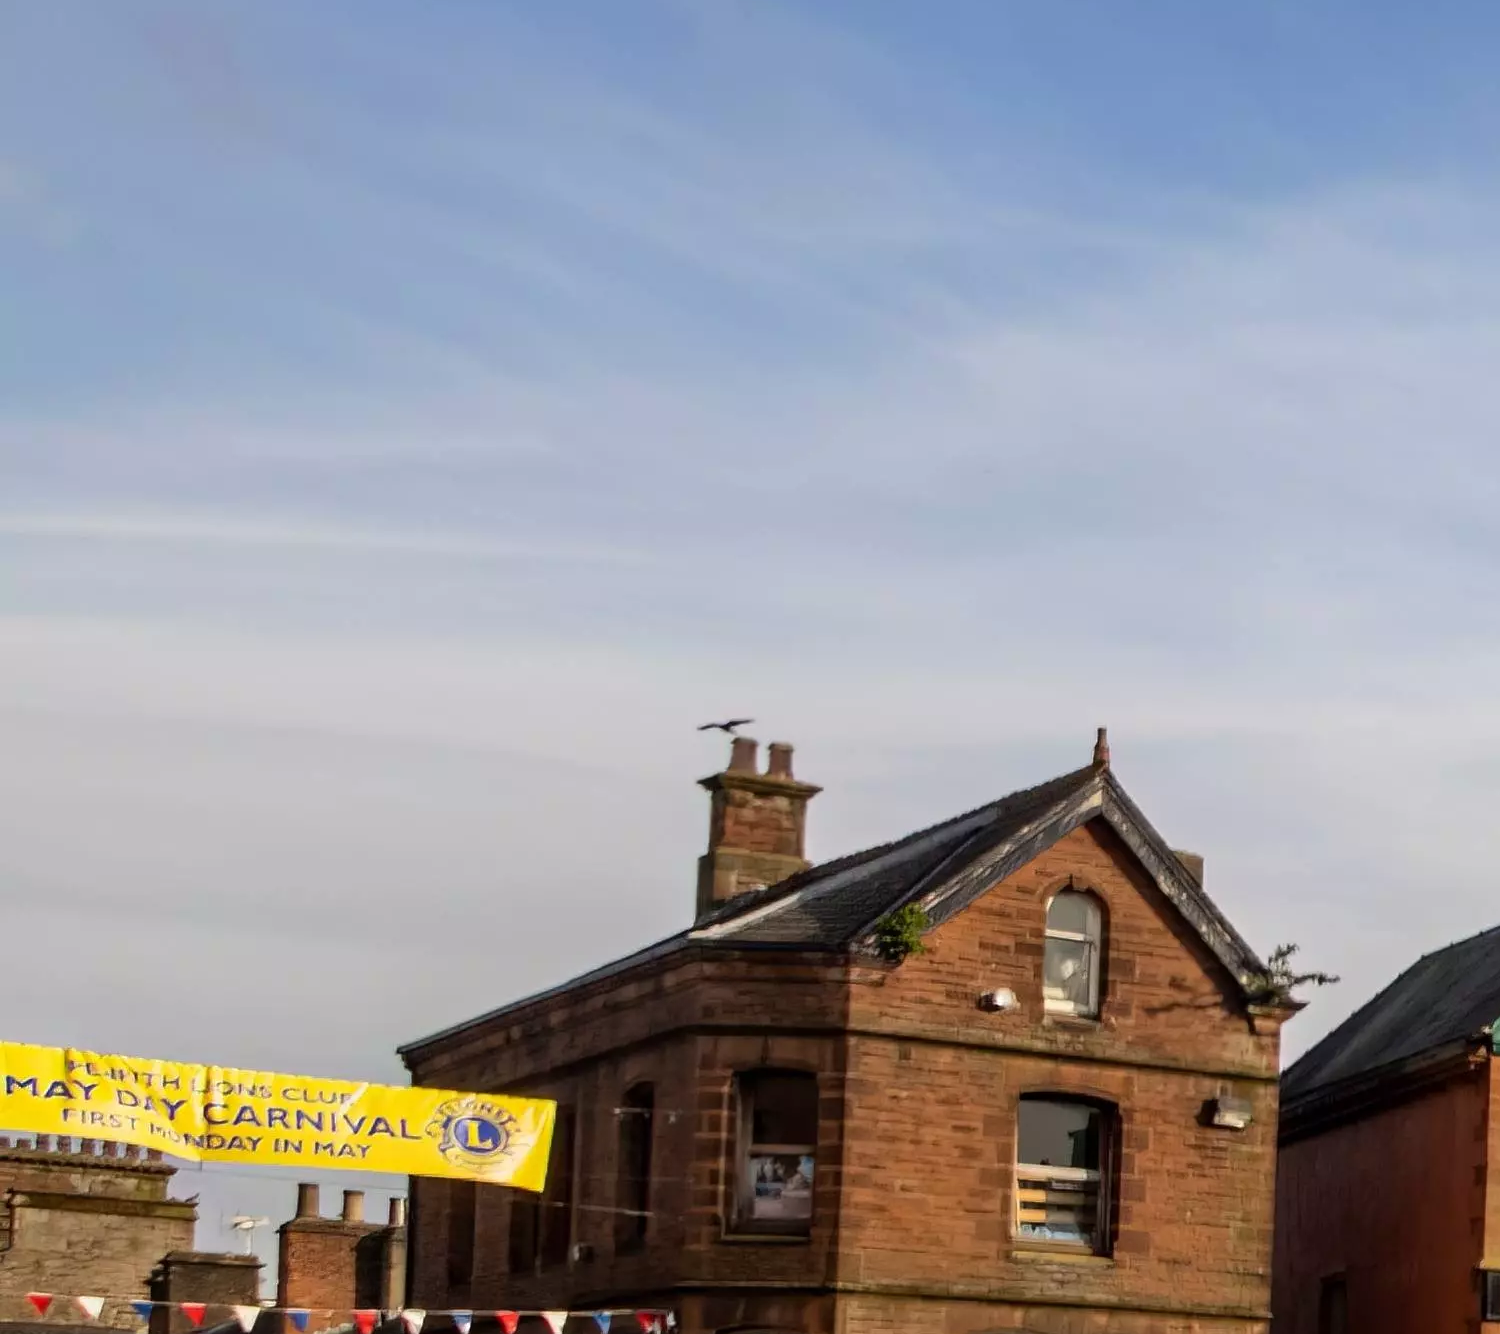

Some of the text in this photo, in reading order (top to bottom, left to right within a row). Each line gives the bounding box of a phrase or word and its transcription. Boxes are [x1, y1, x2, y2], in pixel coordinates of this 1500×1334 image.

[5, 1074, 100, 1100] MAY
[117, 1090, 187, 1121] DAY
[203, 1103, 422, 1140] CARNIVAL
[62, 1107, 141, 1130] FIRST
[273, 1138, 302, 1154] IN
[314, 1140, 371, 1158] MAY
